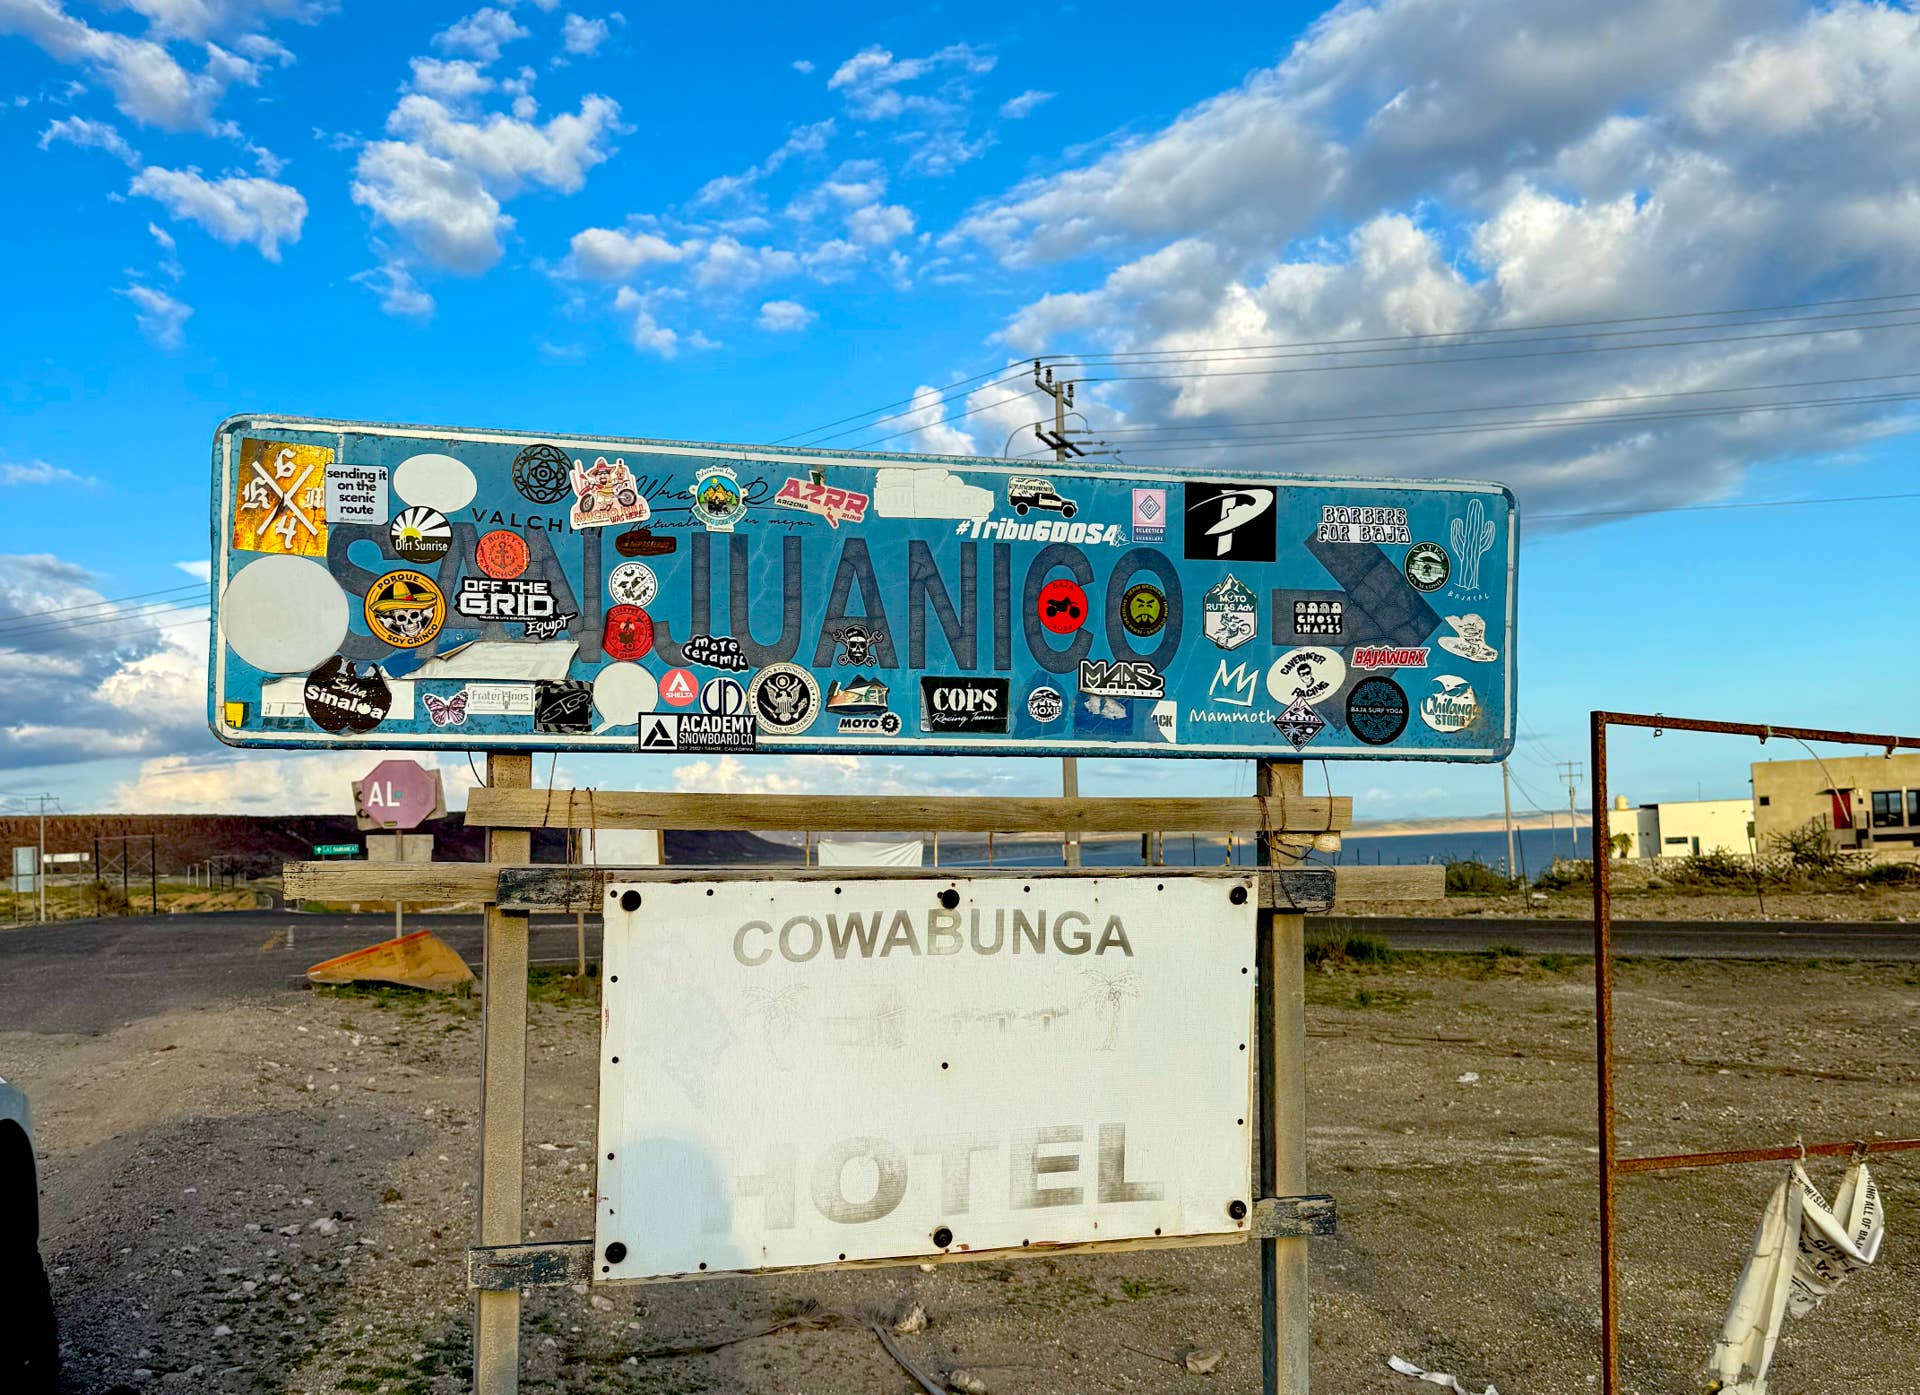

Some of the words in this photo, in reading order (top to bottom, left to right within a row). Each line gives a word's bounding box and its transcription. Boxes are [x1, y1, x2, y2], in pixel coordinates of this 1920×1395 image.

[327, 468, 376, 482] sending
[379, 469, 387, 481] it
[337, 482, 354, 490] on
[356, 480, 376, 491] the
[339, 492, 375, 503] scenic
[777, 478, 868, 515] AZRR
[340, 505, 374, 514] route
[776, 499, 808, 510] ARIZONA
[1322, 505, 1408, 525] BARBERS
[1316, 523, 1350, 542] FOR
[1359, 524, 1412, 543] BAJA
[396, 537, 412, 550] Dirt
[415, 540, 448, 551] Sunrise
[464, 580, 503, 591] OFF
[507, 581, 548, 594] THE
[327, 521, 602, 663] SAN
[652, 531, 1184, 676] JUANICO
[460, 592, 554, 616] GRID
[1219, 593, 1247, 603] MOTO
[1236, 603, 1254, 611] Adv
[526, 613, 576, 638] Equipt
[1297, 615, 1341, 624] GHOST
[387, 634, 405, 644] SOY
[407, 624, 438, 645] GRINGO
[1296, 624, 1342, 634] SHAPES
[695, 637, 738, 652] more
[1353, 647, 1427, 668] BAJAWORX
[331, 678, 368, 698] Salsa
[305, 685, 384, 720] Sinaloa
[933, 688, 999, 712] COPS
[1030, 706, 1061, 714] MOXIE
[1189, 708, 1276, 723] Mammoth
[680, 715, 755, 733] ACADEMY
[840, 718, 879, 729] MOTO
[885, 717, 895, 729] 3
[932, 711, 968, 727] Racing
[679, 732, 740, 745] SNOWBOARD
[733, 909, 1134, 967] COWABUNGA
[701, 1122, 1165, 1234] HOTEL
[1863, 1199, 1875, 1215] ALL
[1861, 1219, 1872, 1230] OF
